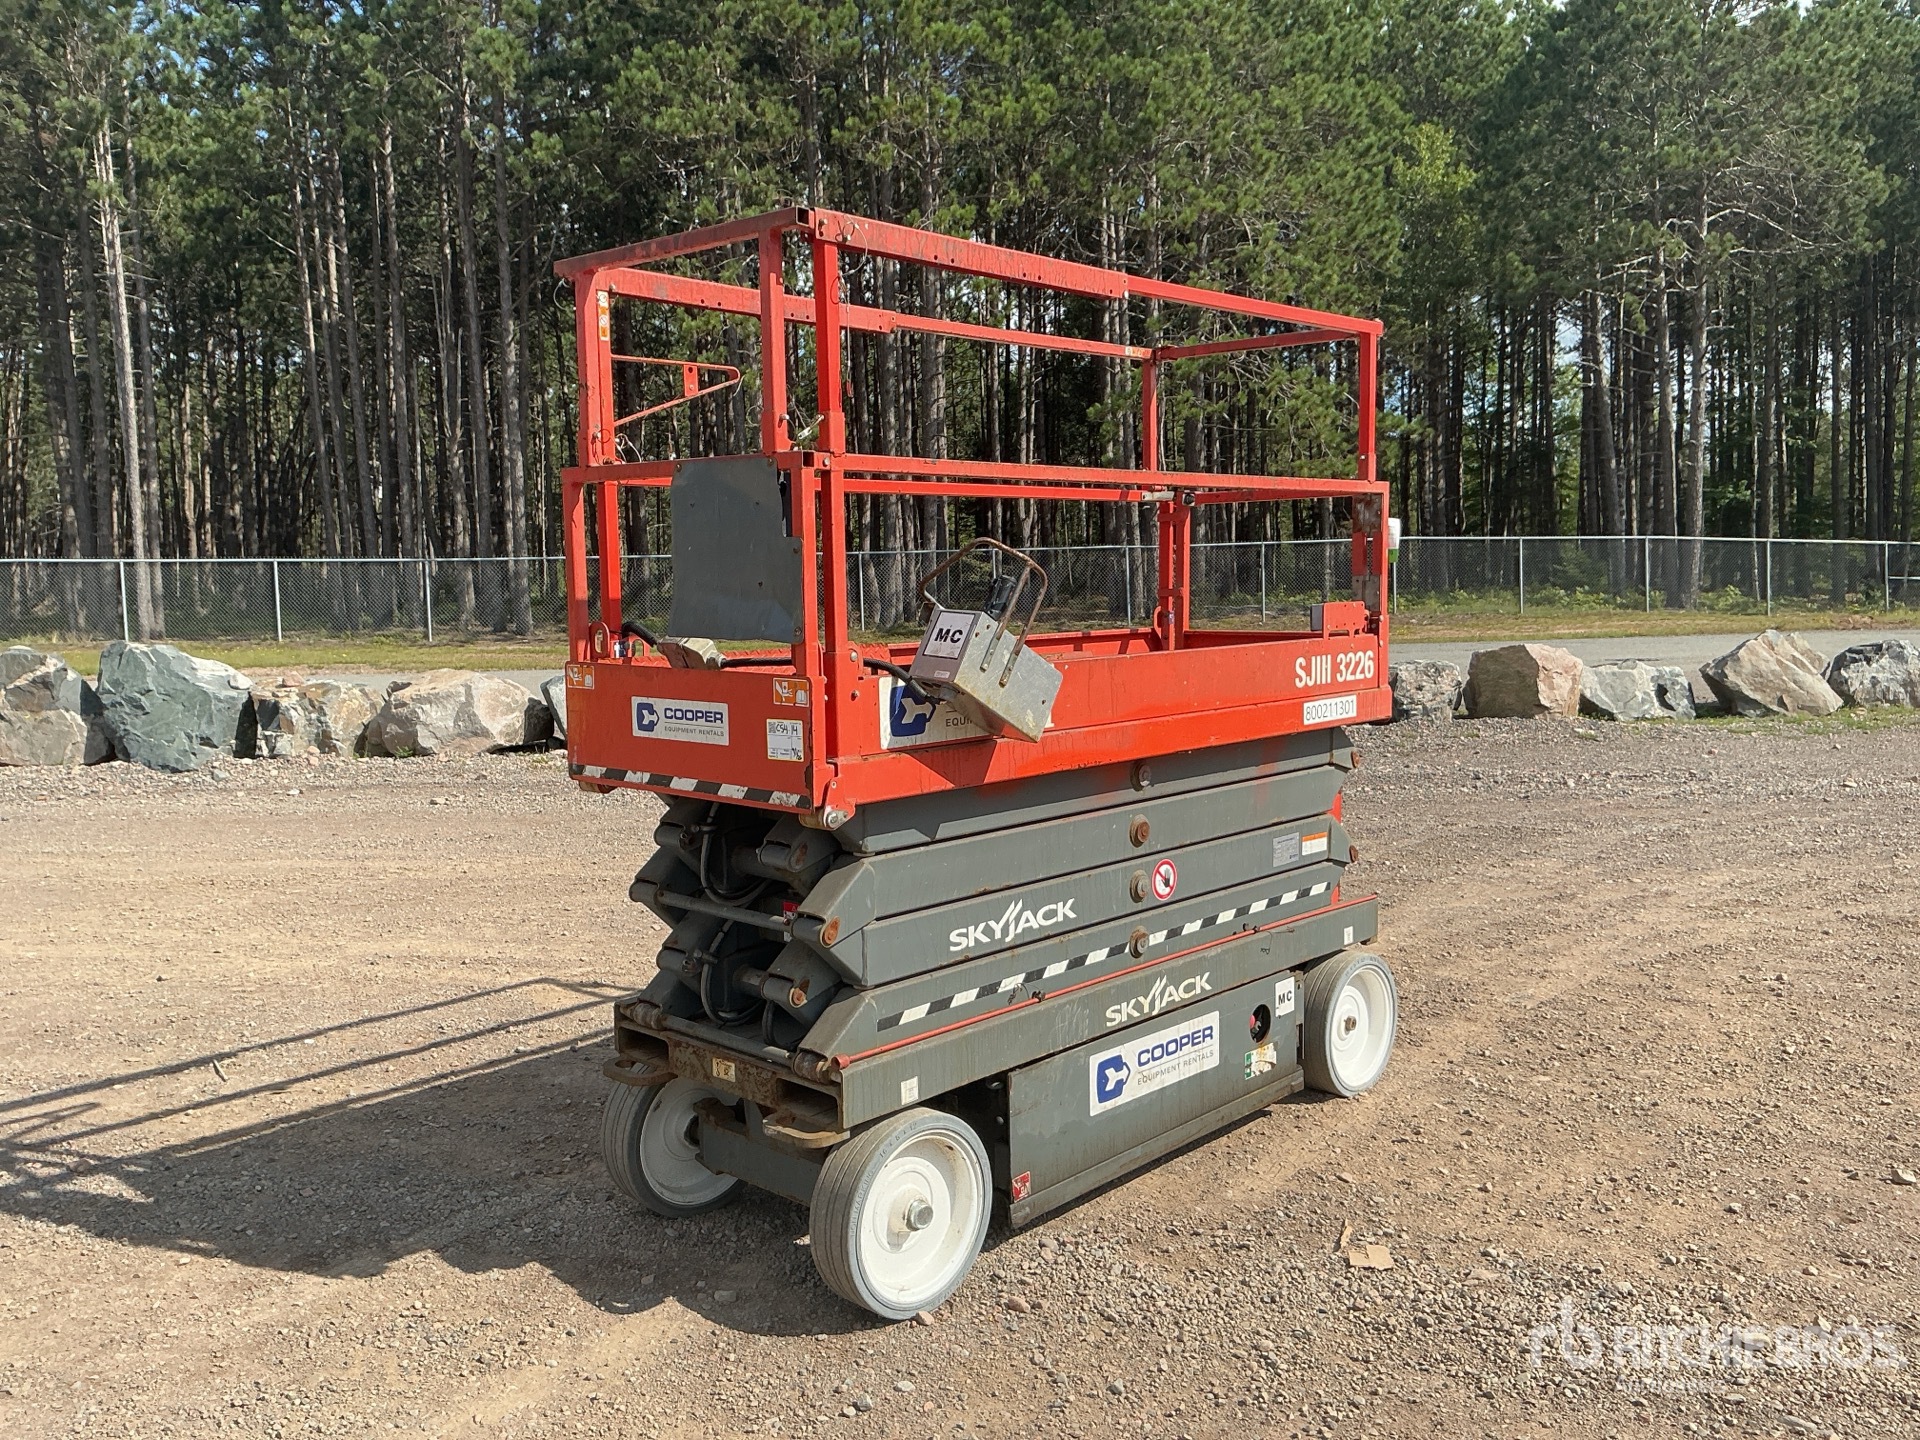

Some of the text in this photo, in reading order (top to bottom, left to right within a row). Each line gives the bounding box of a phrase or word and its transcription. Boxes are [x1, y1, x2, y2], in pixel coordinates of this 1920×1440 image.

[934, 627, 963, 643] MC
[1336, 650, 1374, 682] 3226
[664, 707, 724, 724] COOPER
[1305, 699, 1355, 721] 800211301
[664, 726, 725, 737] EQUIPMENT RENTALS
[949, 898, 1077, 952] SKYJACK
[1105, 971, 1212, 1027] SKYJACK
[1278, 990, 1293, 1006] MC
[1137, 1025, 1214, 1067] COOPER
[1137, 1050, 1214, 1086] EQUIPMENT RENTALS
